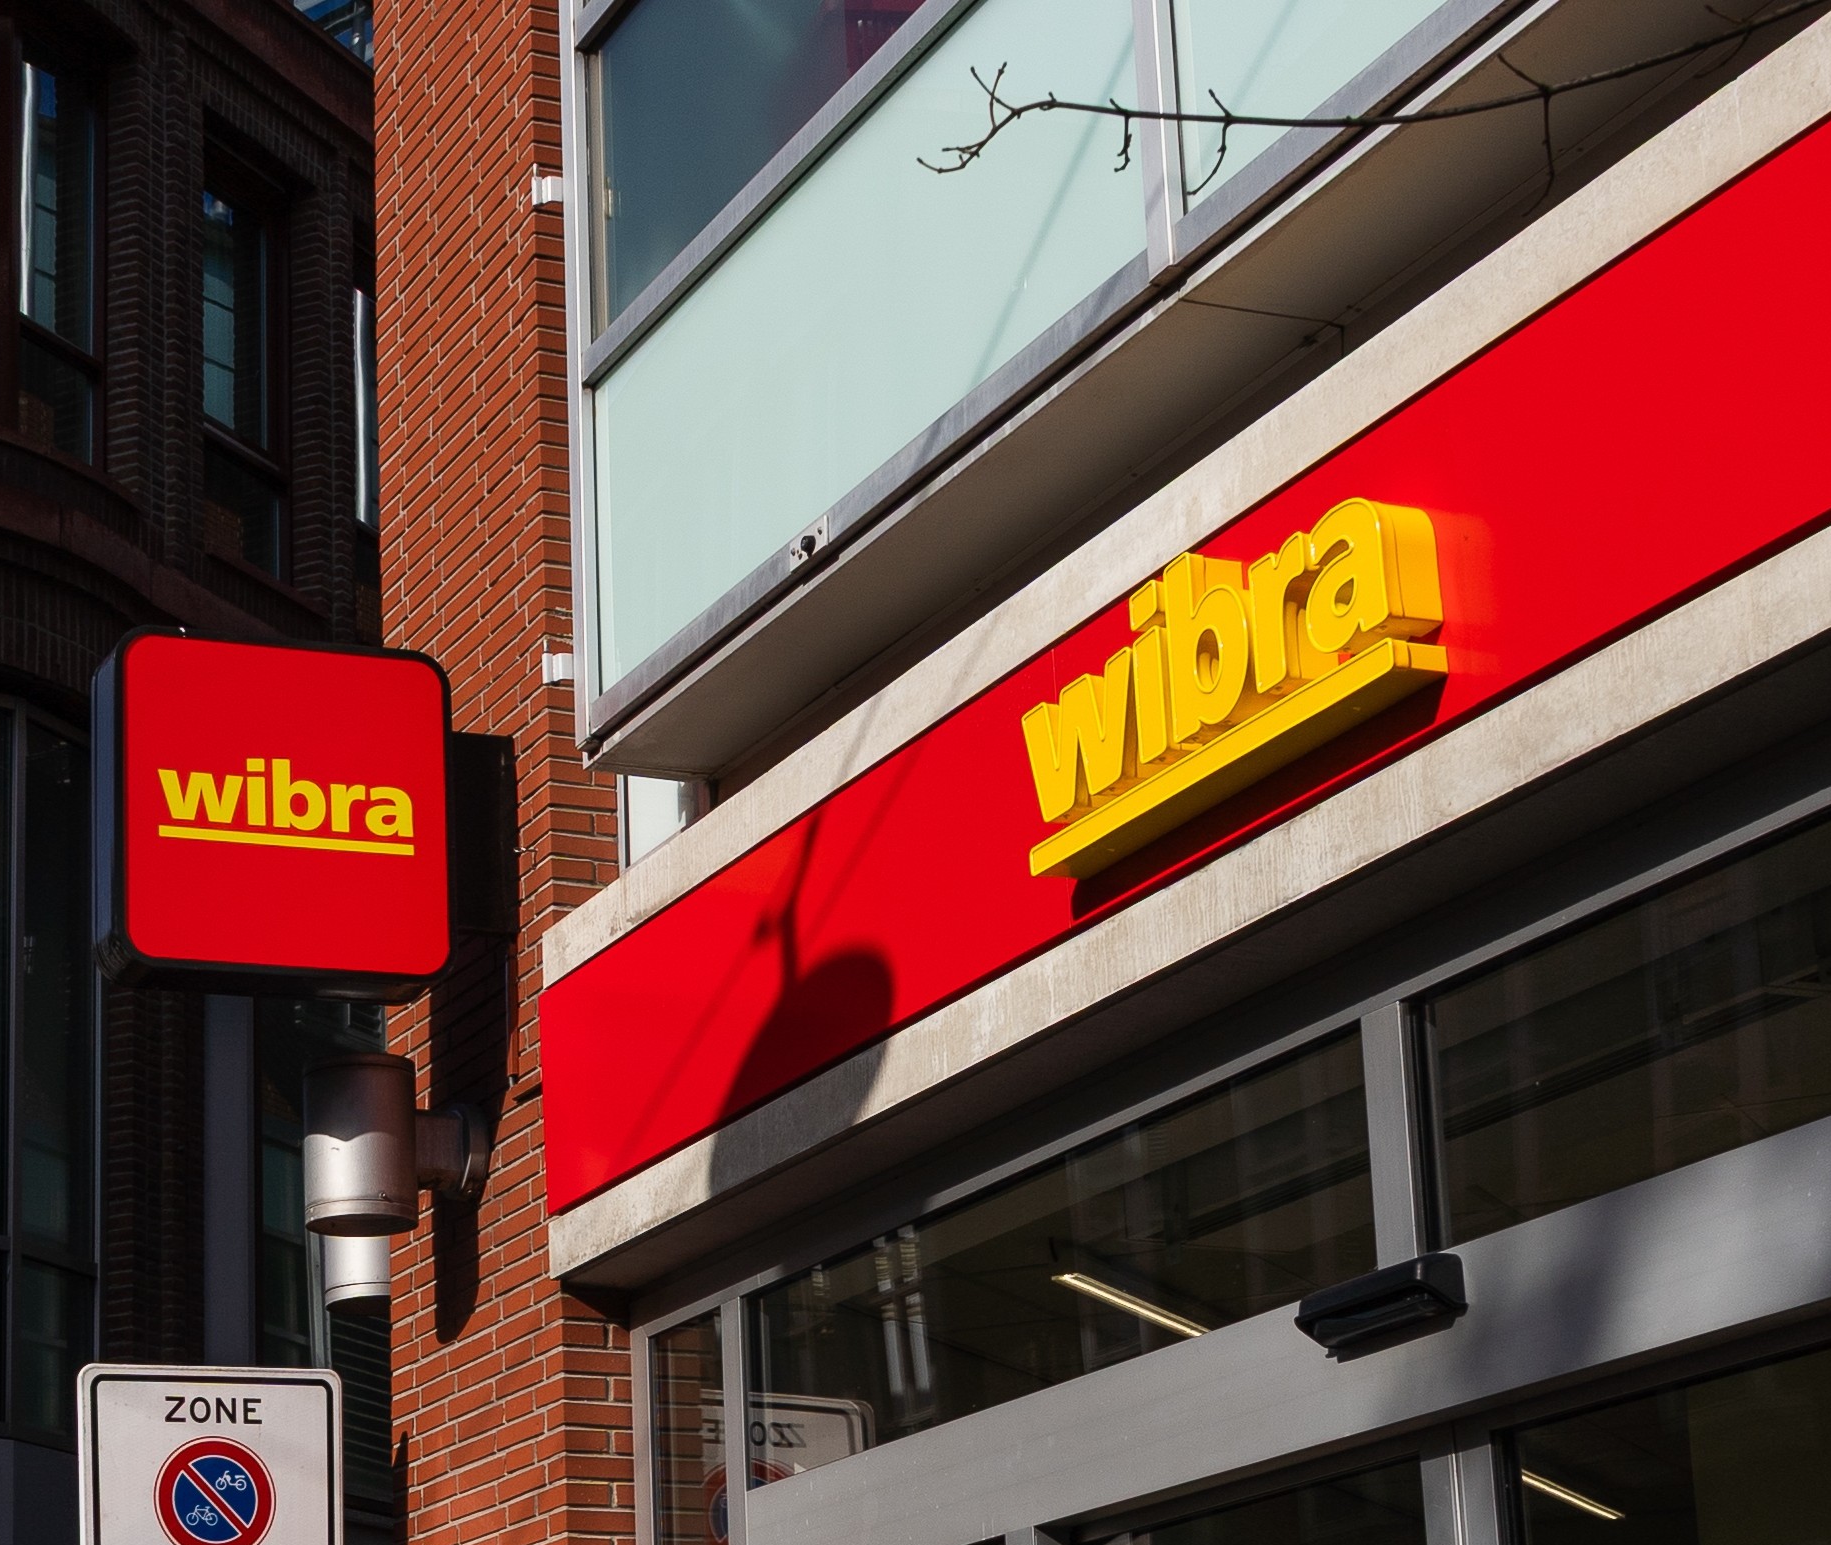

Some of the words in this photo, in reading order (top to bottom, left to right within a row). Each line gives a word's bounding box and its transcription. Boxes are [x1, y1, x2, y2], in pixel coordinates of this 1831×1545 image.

[1021, 497, 1441, 825] wibra
[158, 758, 414, 838] wibra
[165, 1396, 263, 1425] ZONE
